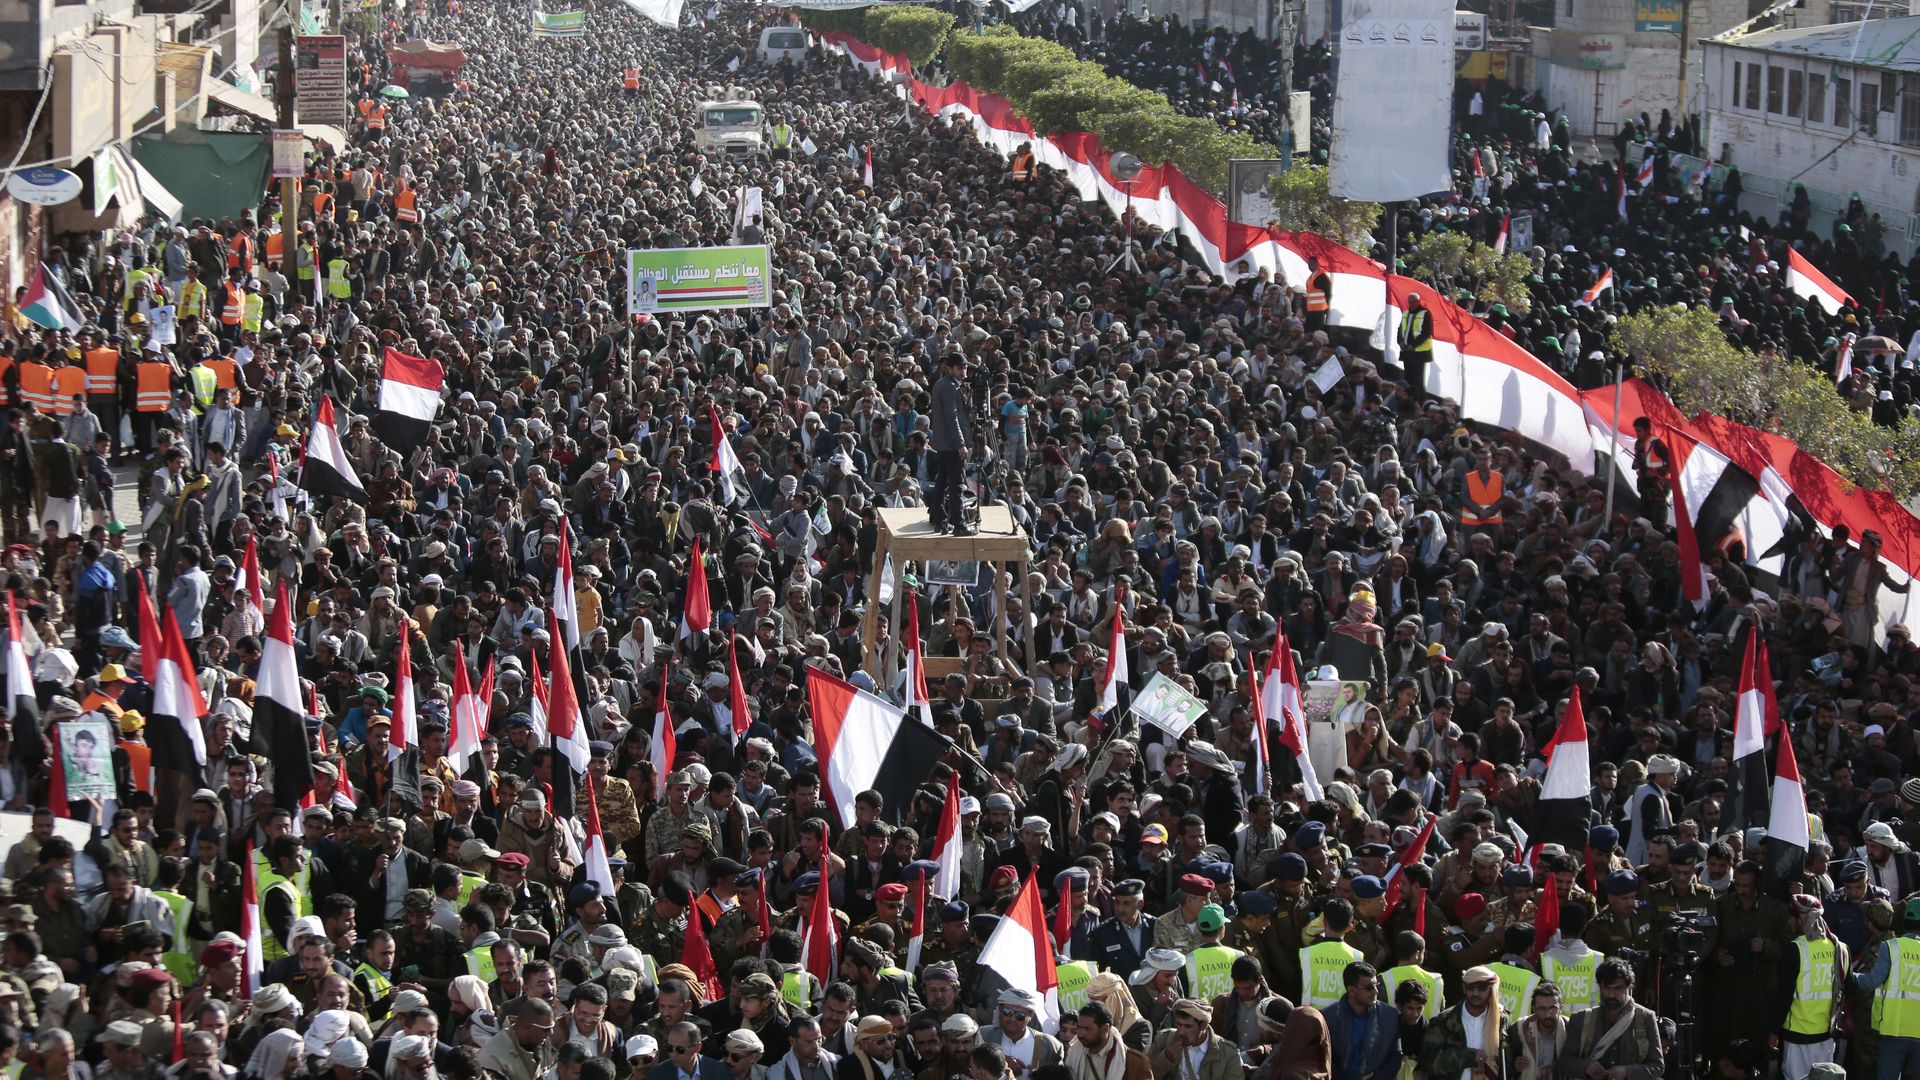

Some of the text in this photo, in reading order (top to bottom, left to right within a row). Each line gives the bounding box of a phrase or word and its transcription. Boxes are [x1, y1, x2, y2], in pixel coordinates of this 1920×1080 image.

[638, 267, 668, 281] العدالة
[671, 265, 710, 285] مستقبل
[714, 263, 739, 283] ننظم
[1812, 951, 1833, 960] ATAM
